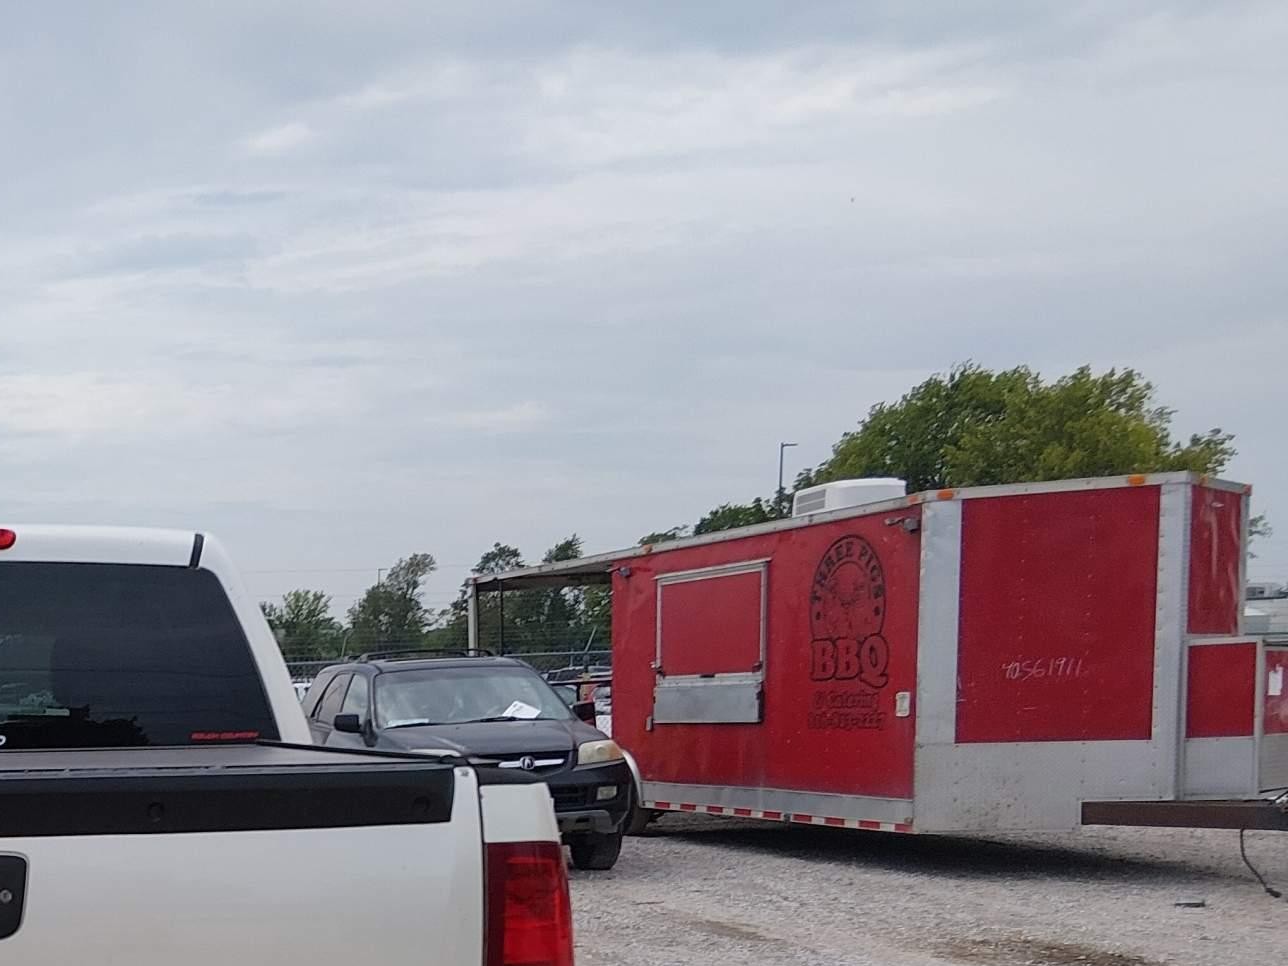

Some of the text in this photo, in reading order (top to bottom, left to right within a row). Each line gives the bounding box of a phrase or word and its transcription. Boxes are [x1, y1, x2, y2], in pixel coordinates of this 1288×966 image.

[810, 541, 884, 605] THREE PIGS
[811, 633, 889, 689] BBQ
